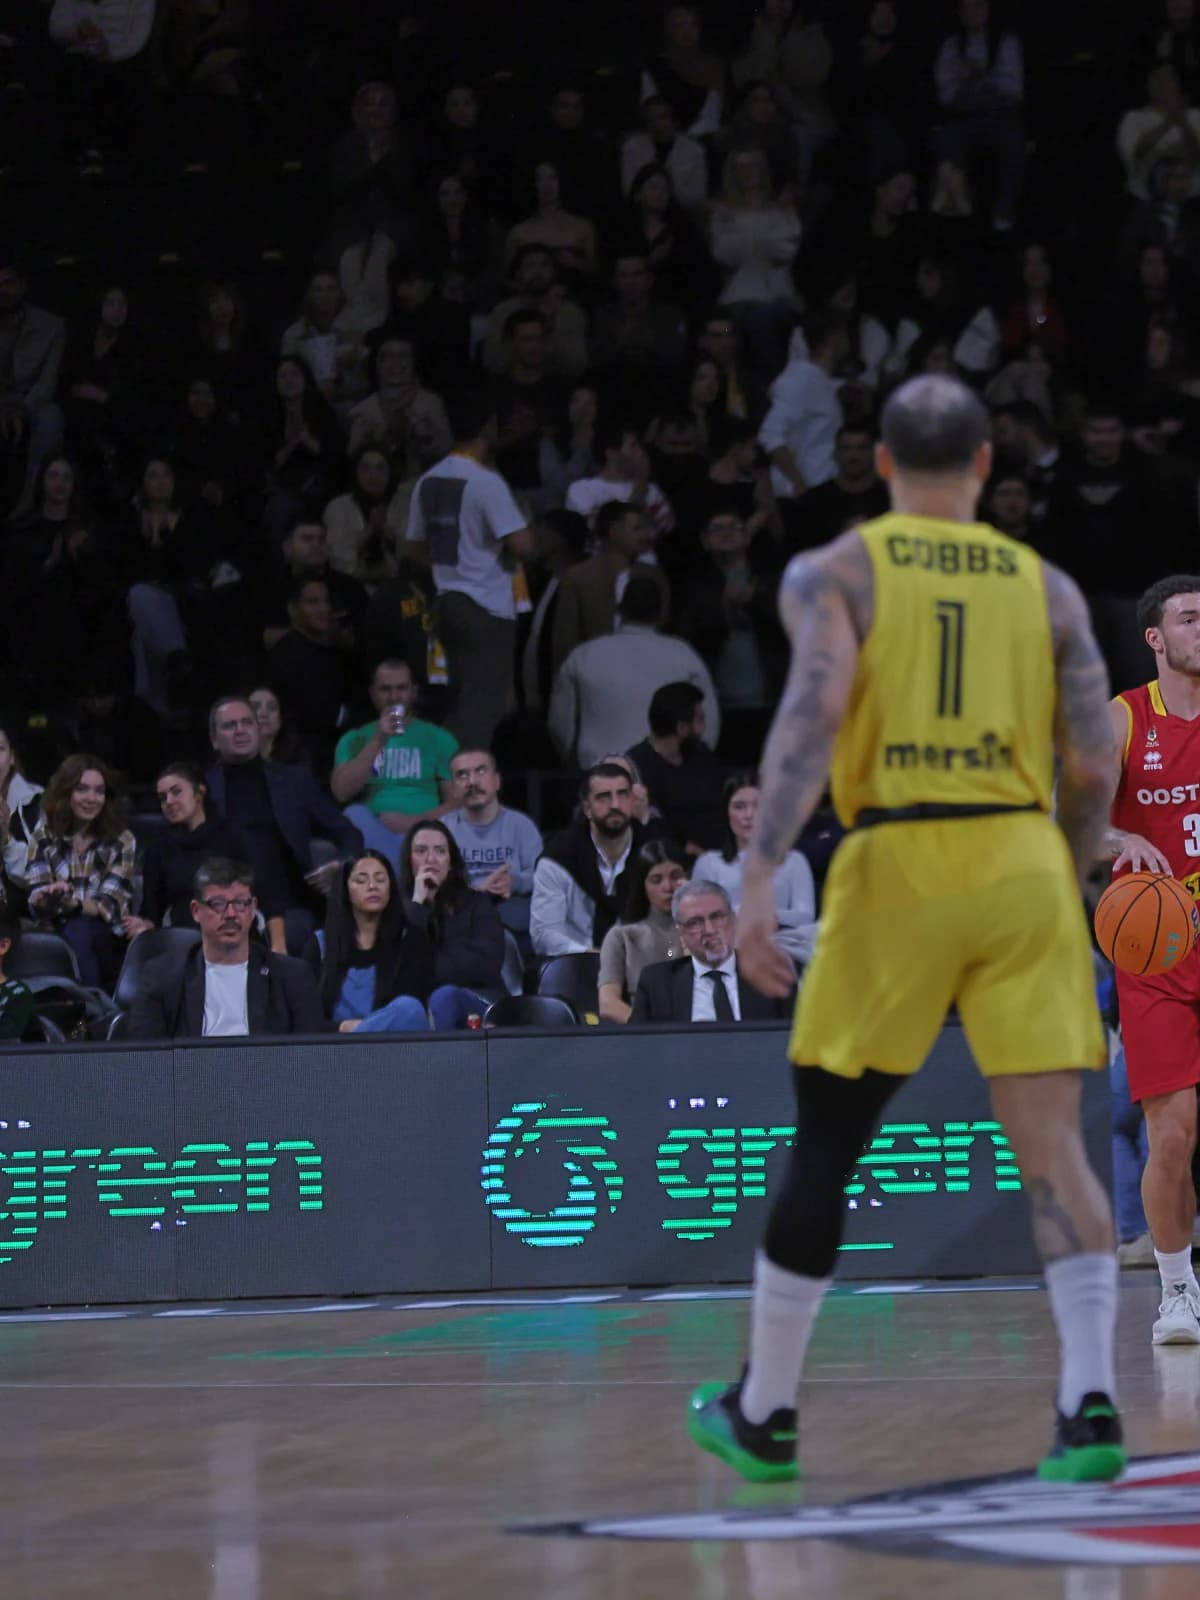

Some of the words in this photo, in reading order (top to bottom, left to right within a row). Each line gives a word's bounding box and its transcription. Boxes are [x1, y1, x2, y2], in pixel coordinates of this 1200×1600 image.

[886, 534, 1018, 576] COBBS
[935, 599, 965, 718] 1
[386, 747, 422, 779] NBA
[884, 731, 1014, 770] mersin
[462, 846, 514, 862] LFIGER
[655, 1120, 1023, 1240] gren
